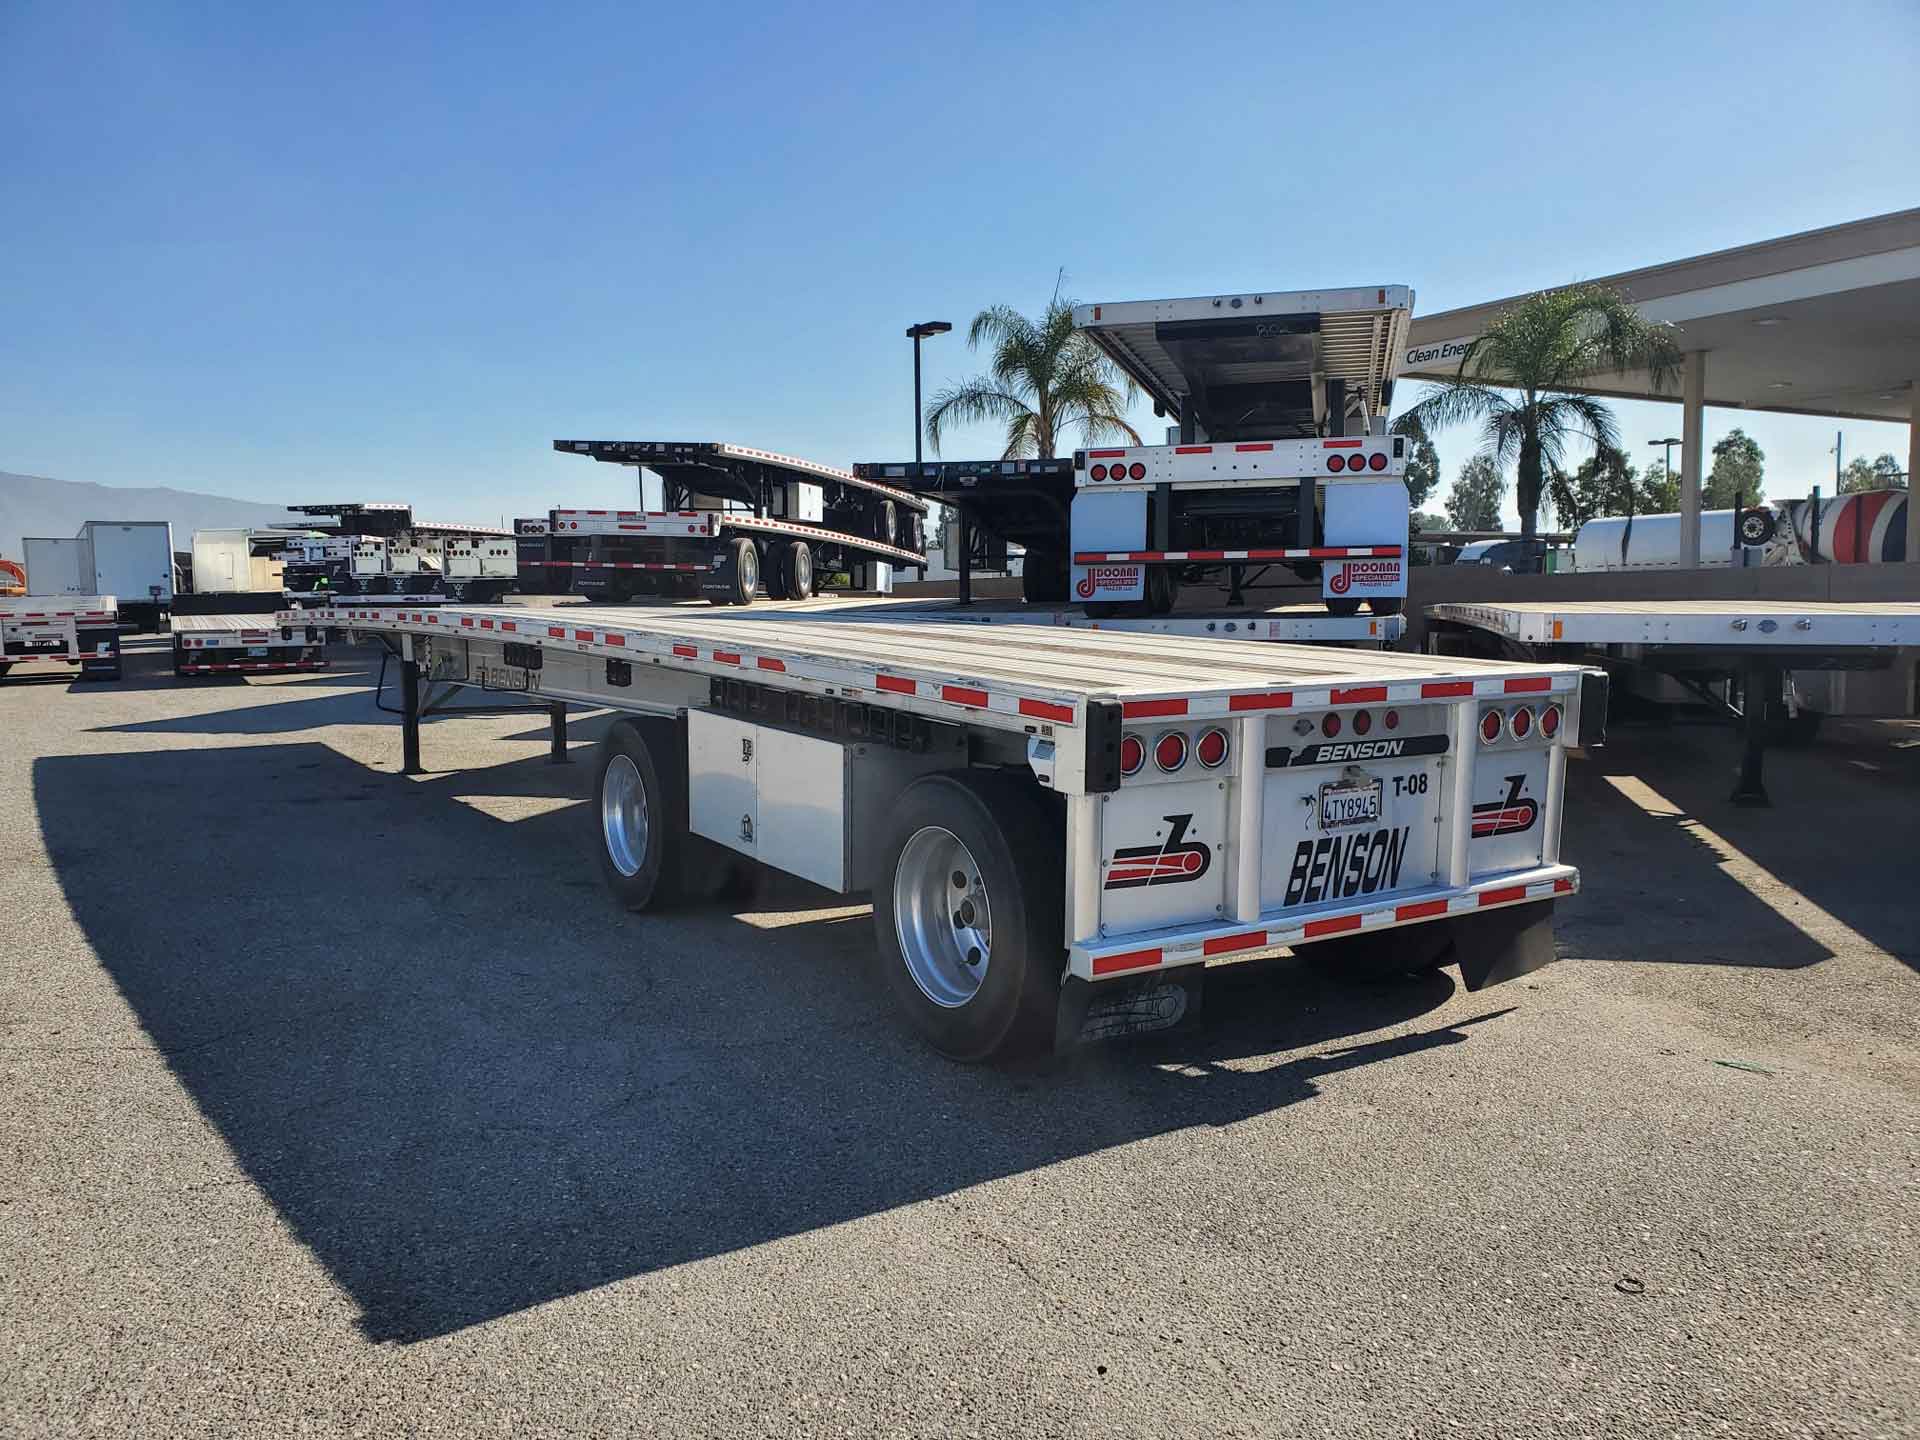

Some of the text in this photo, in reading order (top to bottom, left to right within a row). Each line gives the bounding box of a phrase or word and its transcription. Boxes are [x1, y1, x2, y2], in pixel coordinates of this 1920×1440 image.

[1406, 342, 1475, 364] Clean Ener
[1315, 740, 1404, 763] BENSON
[1392, 773, 1428, 797] T-08
[1324, 795, 1377, 820] 4TY8945
[1283, 826, 1410, 907] BENSON
